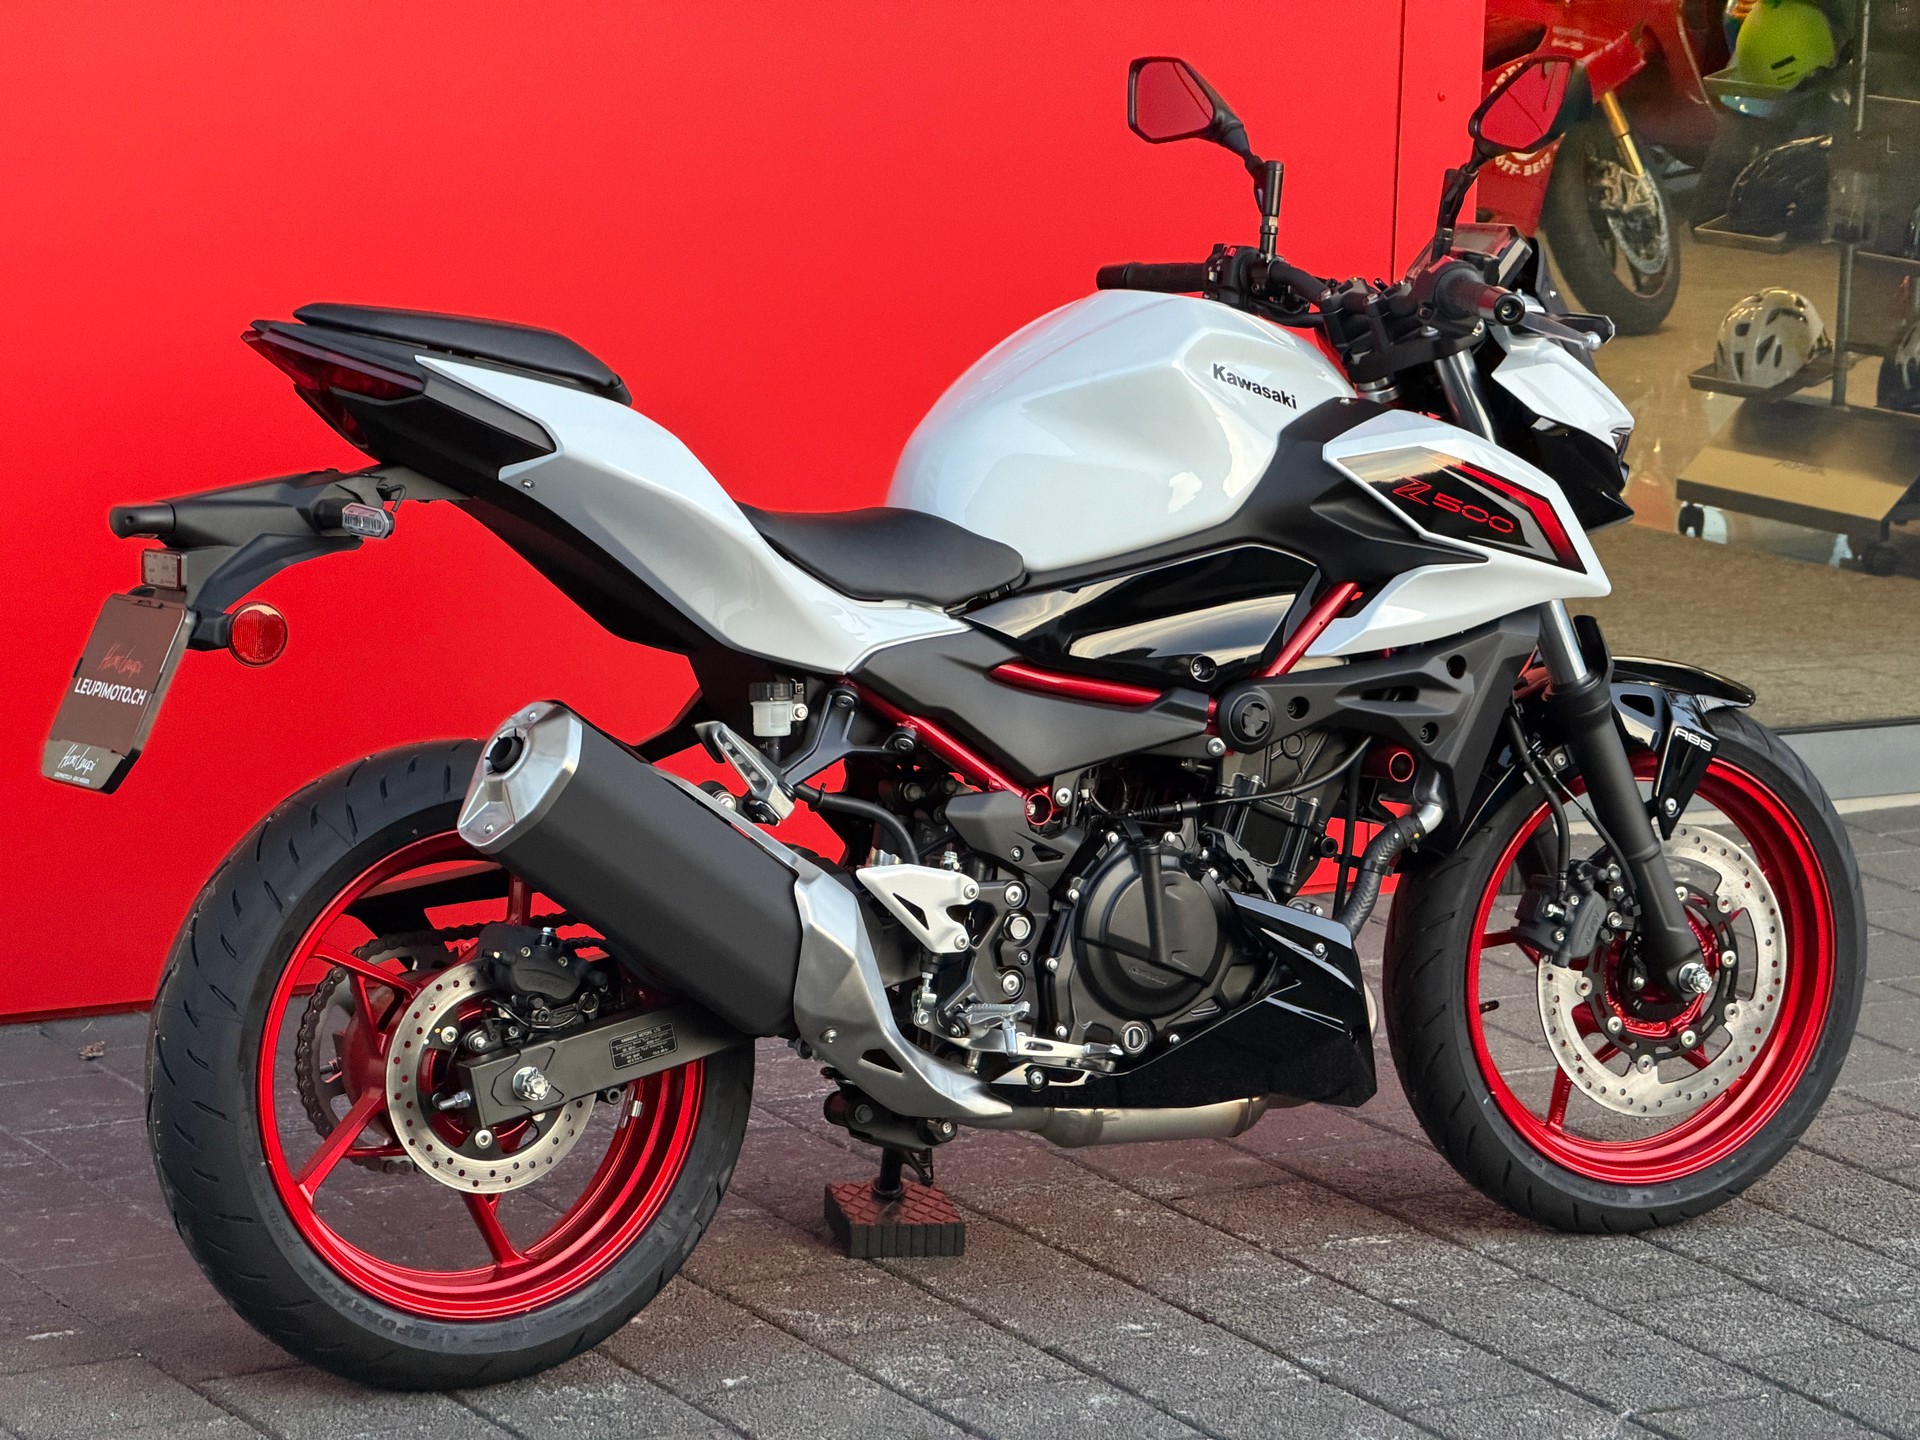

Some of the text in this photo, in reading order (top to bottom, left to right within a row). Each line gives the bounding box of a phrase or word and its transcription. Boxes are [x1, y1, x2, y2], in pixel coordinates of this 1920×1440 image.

[1213, 363, 1297, 410] Kawasaki
[74, 677, 148, 706] LEUPIMOTO.CH
[1674, 727, 1712, 752] ABS
